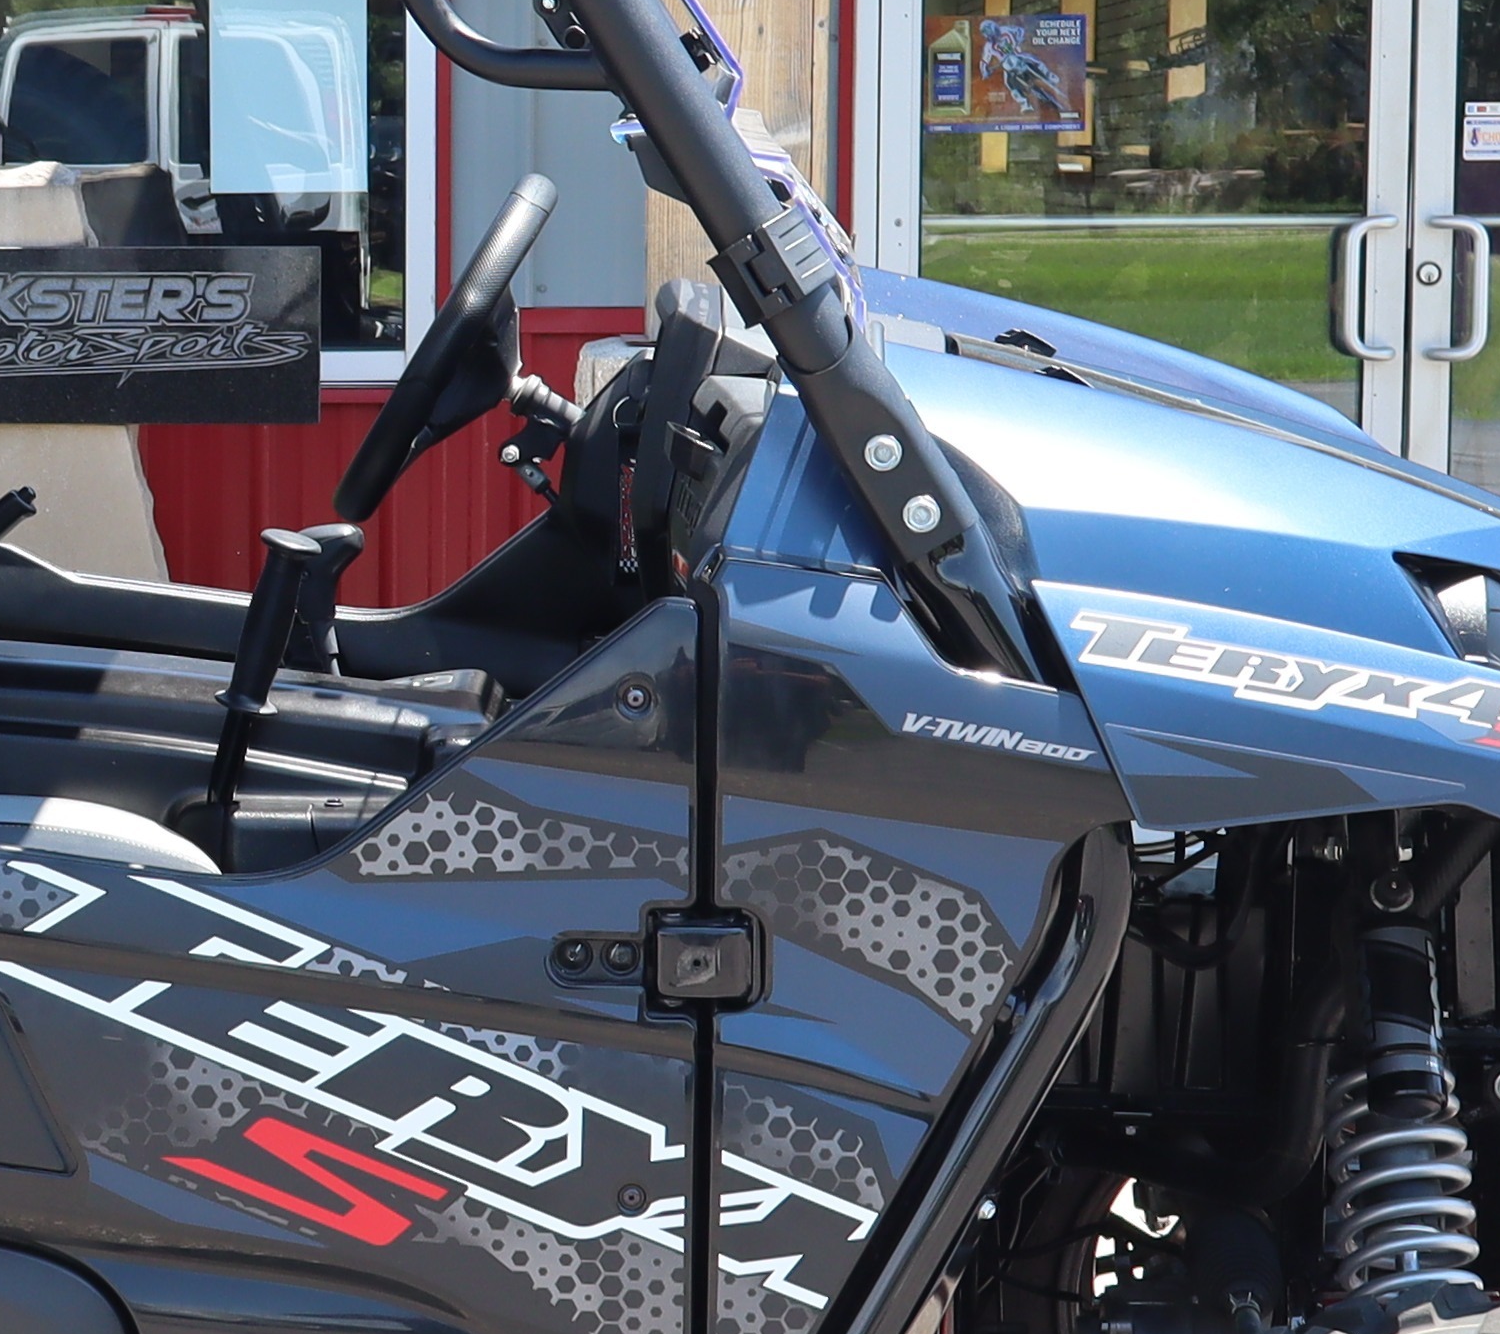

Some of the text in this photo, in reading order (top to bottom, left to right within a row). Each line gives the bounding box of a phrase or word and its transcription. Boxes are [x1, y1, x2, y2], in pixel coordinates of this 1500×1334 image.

[1039, 19, 1082, 28] SCHEDULE
[1059, 28, 1081, 37] NEXT
[1031, 37, 1082, 45] OIL CHANGE
[160, 1117, 449, 1248] S
